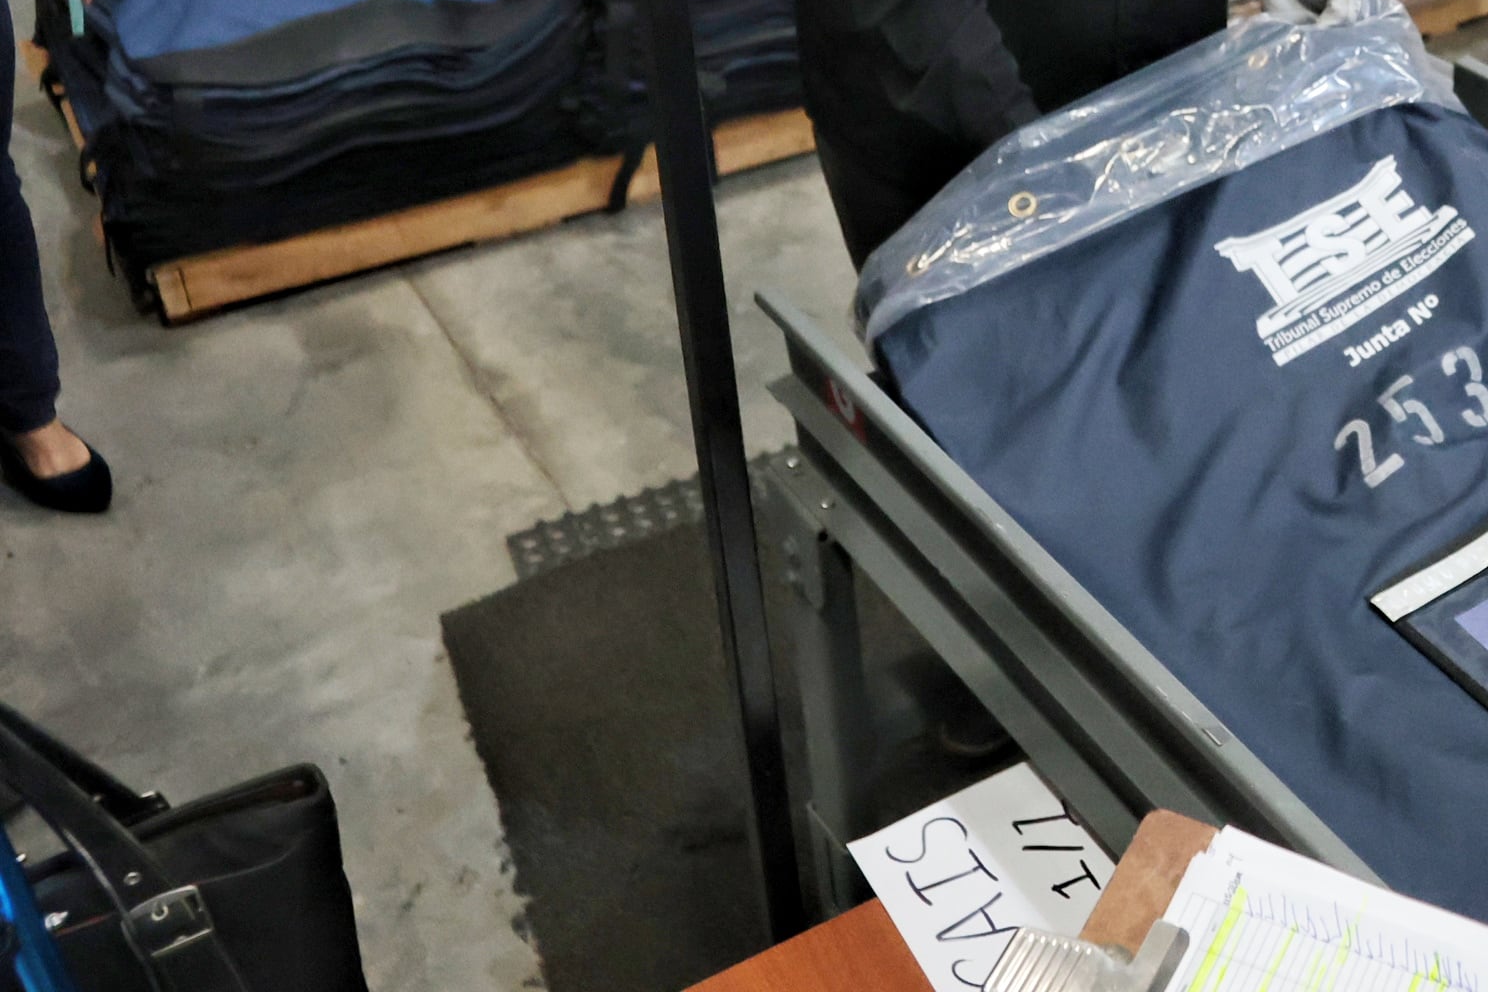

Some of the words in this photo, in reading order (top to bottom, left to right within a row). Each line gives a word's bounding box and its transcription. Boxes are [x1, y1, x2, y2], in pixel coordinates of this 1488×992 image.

[1214, 154, 1433, 308] TSE
[1264, 314, 1320, 352] Tribunal
[1316, 280, 1382, 323] Supremo
[1381, 268, 1402, 285] de
[1400, 218, 1468, 274] Elecciones
[1343, 318, 1411, 367] Junta
[1407, 293, 1440, 326] Nº
